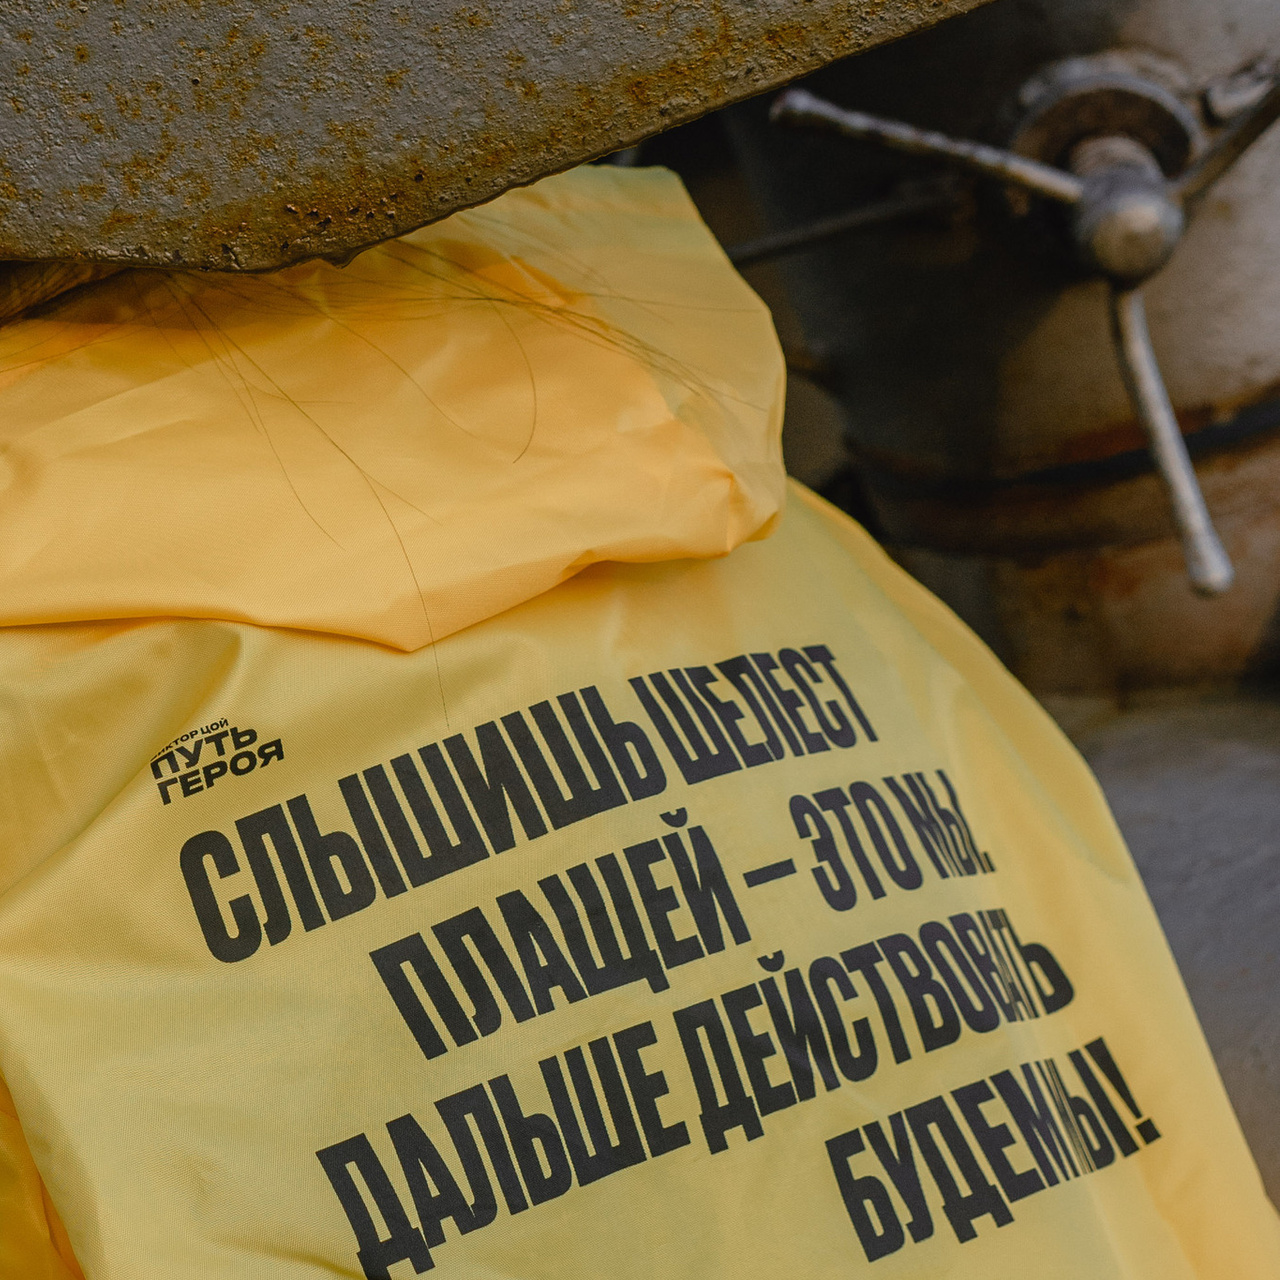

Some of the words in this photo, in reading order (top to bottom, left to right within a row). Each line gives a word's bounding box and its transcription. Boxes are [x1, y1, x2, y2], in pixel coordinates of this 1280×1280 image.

[150, 729, 199, 761] ИКТОР
[200, 717, 229, 735] ЦОЙ
[150, 726, 258, 780] ПУТЬ
[157, 738, 285, 806] ГЕРОЯ
[179, 685, 668, 964] СЛЫШИШЬ
[628, 644, 879, 786] ШЕЛЕСТ
[368, 807, 752, 1060] ПЛАЩЕЙ
[789, 781, 924, 912] ЭТО
